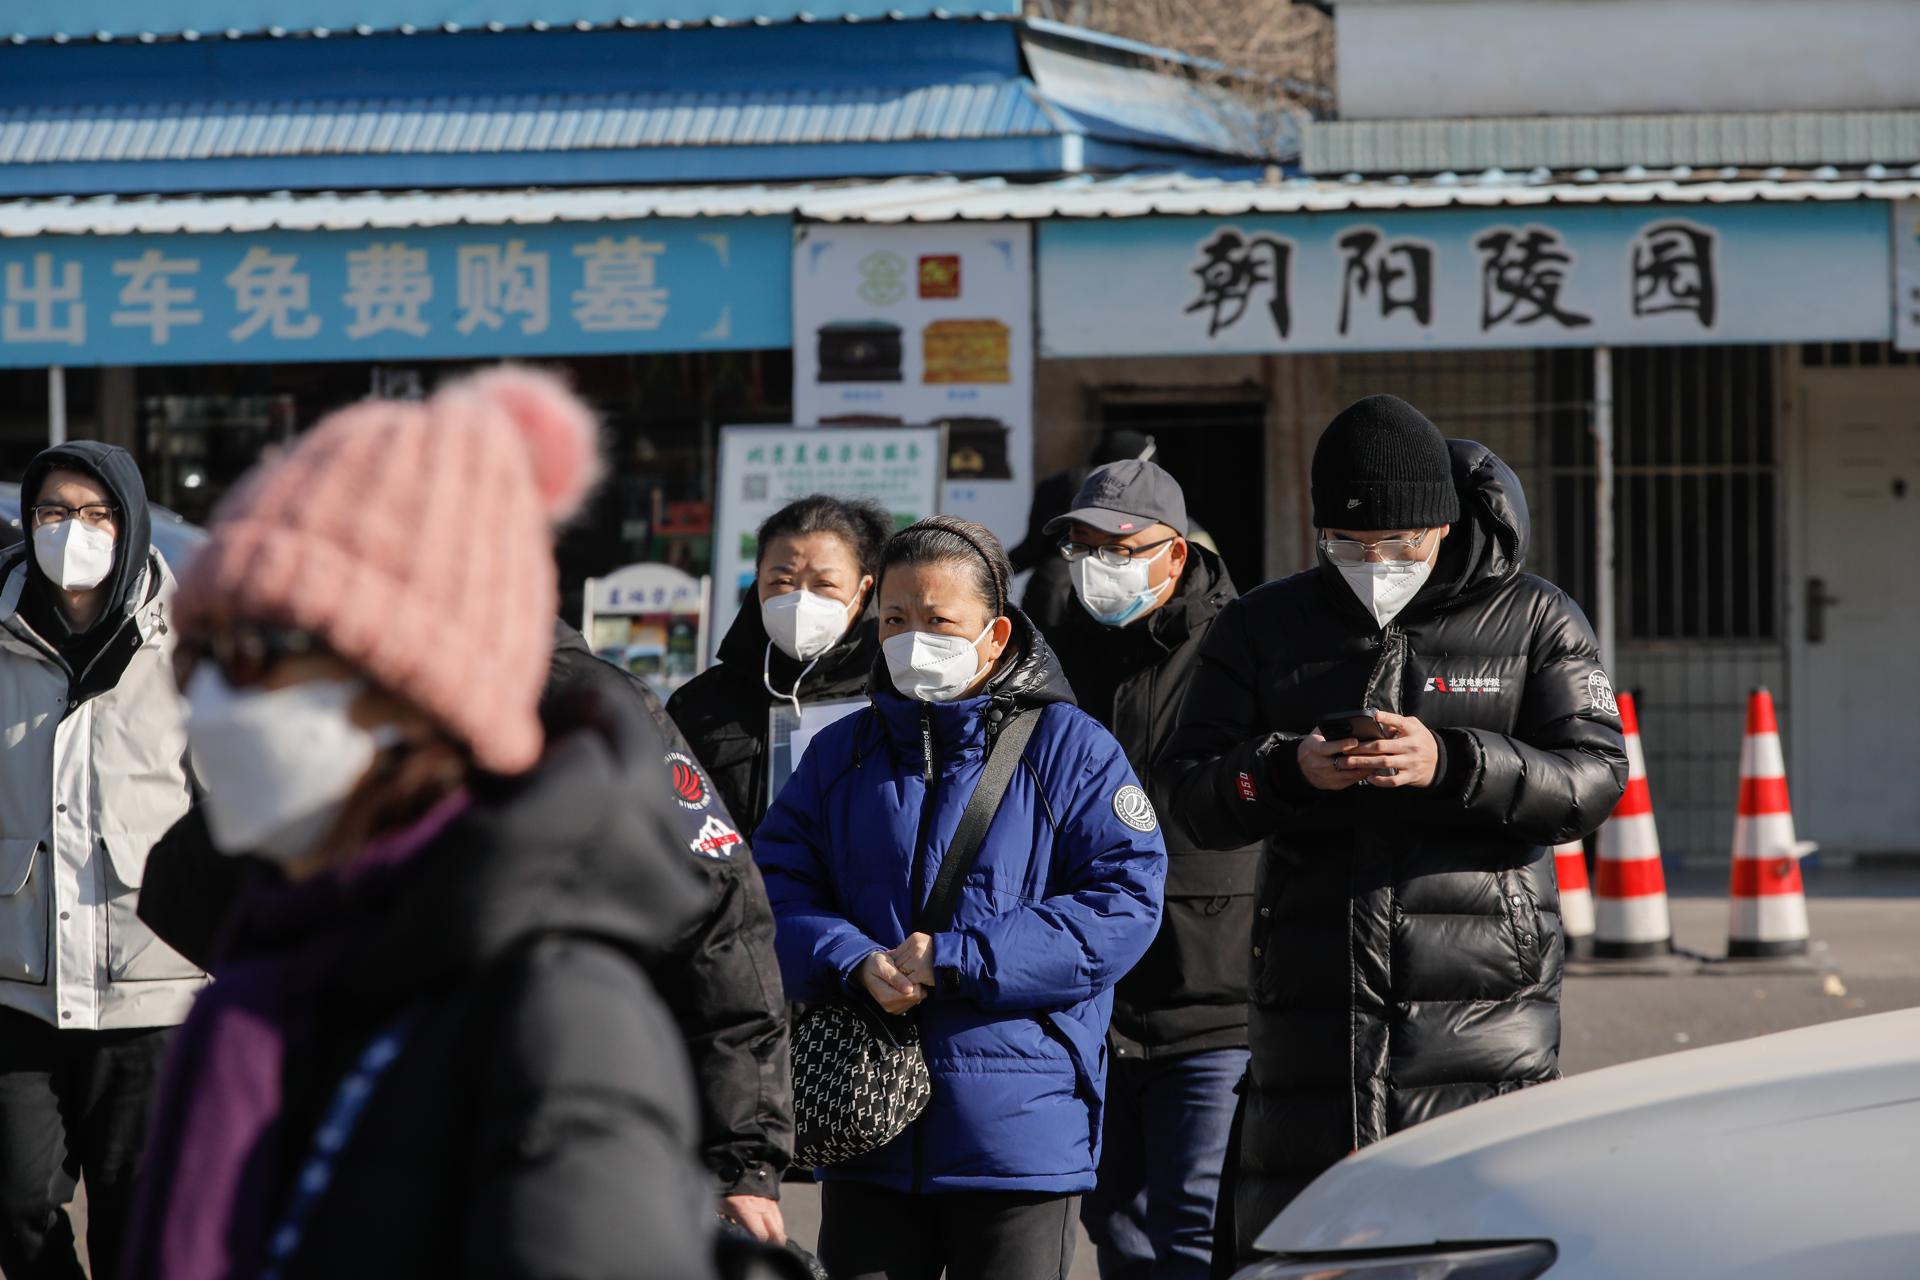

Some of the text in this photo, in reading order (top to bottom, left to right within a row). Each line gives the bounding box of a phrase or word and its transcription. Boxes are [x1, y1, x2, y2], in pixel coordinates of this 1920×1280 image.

[1182, 221, 1720, 339] 朝阳陵园
[4, 236, 669, 345] 出车免费购墓
[1449, 677, 1500, 687] 北京电影学院
[811, 1020, 826, 1030] FJ
[824, 1028, 840, 1040] FJ
[808, 1041, 824, 1052] FJ
[838, 1038, 853, 1051] FJ
[795, 1053, 808, 1066] FJ
[822, 1052, 838, 1063] FJ
[835, 1057, 848, 1070] FJ
[893, 1050, 906, 1067] FJ
[906, 1053, 917, 1070] FJ
[807, 1063, 823, 1075] FJ
[851, 1063, 866, 1077] FJ
[795, 1075, 807, 1089] FJ
[819, 1071, 834, 1083] FJ
[829, 1075, 843, 1089] FJ
[883, 1069, 897, 1085] FJ
[805, 1084, 819, 1097] FJ
[841, 1079, 853, 1095] FJ
[854, 1083, 869, 1099] FJ
[903, 1076, 917, 1093] FJ
[918, 1082, 931, 1098] FJ
[817, 1090, 829, 1104] FJ
[829, 1097, 841, 1111] FJ
[795, 1098, 805, 1112] FJ
[841, 1102, 851, 1118] FJ
[806, 1105, 817, 1120] FJ
[858, 1104, 872, 1121] FJ
[818, 1113, 830, 1127] FJ
[831, 1119, 842, 1134] FJ
[797, 1121, 807, 1135] FJ
[843, 1124, 856, 1139] FJ
[824, 1136, 837, 1149] FJ
